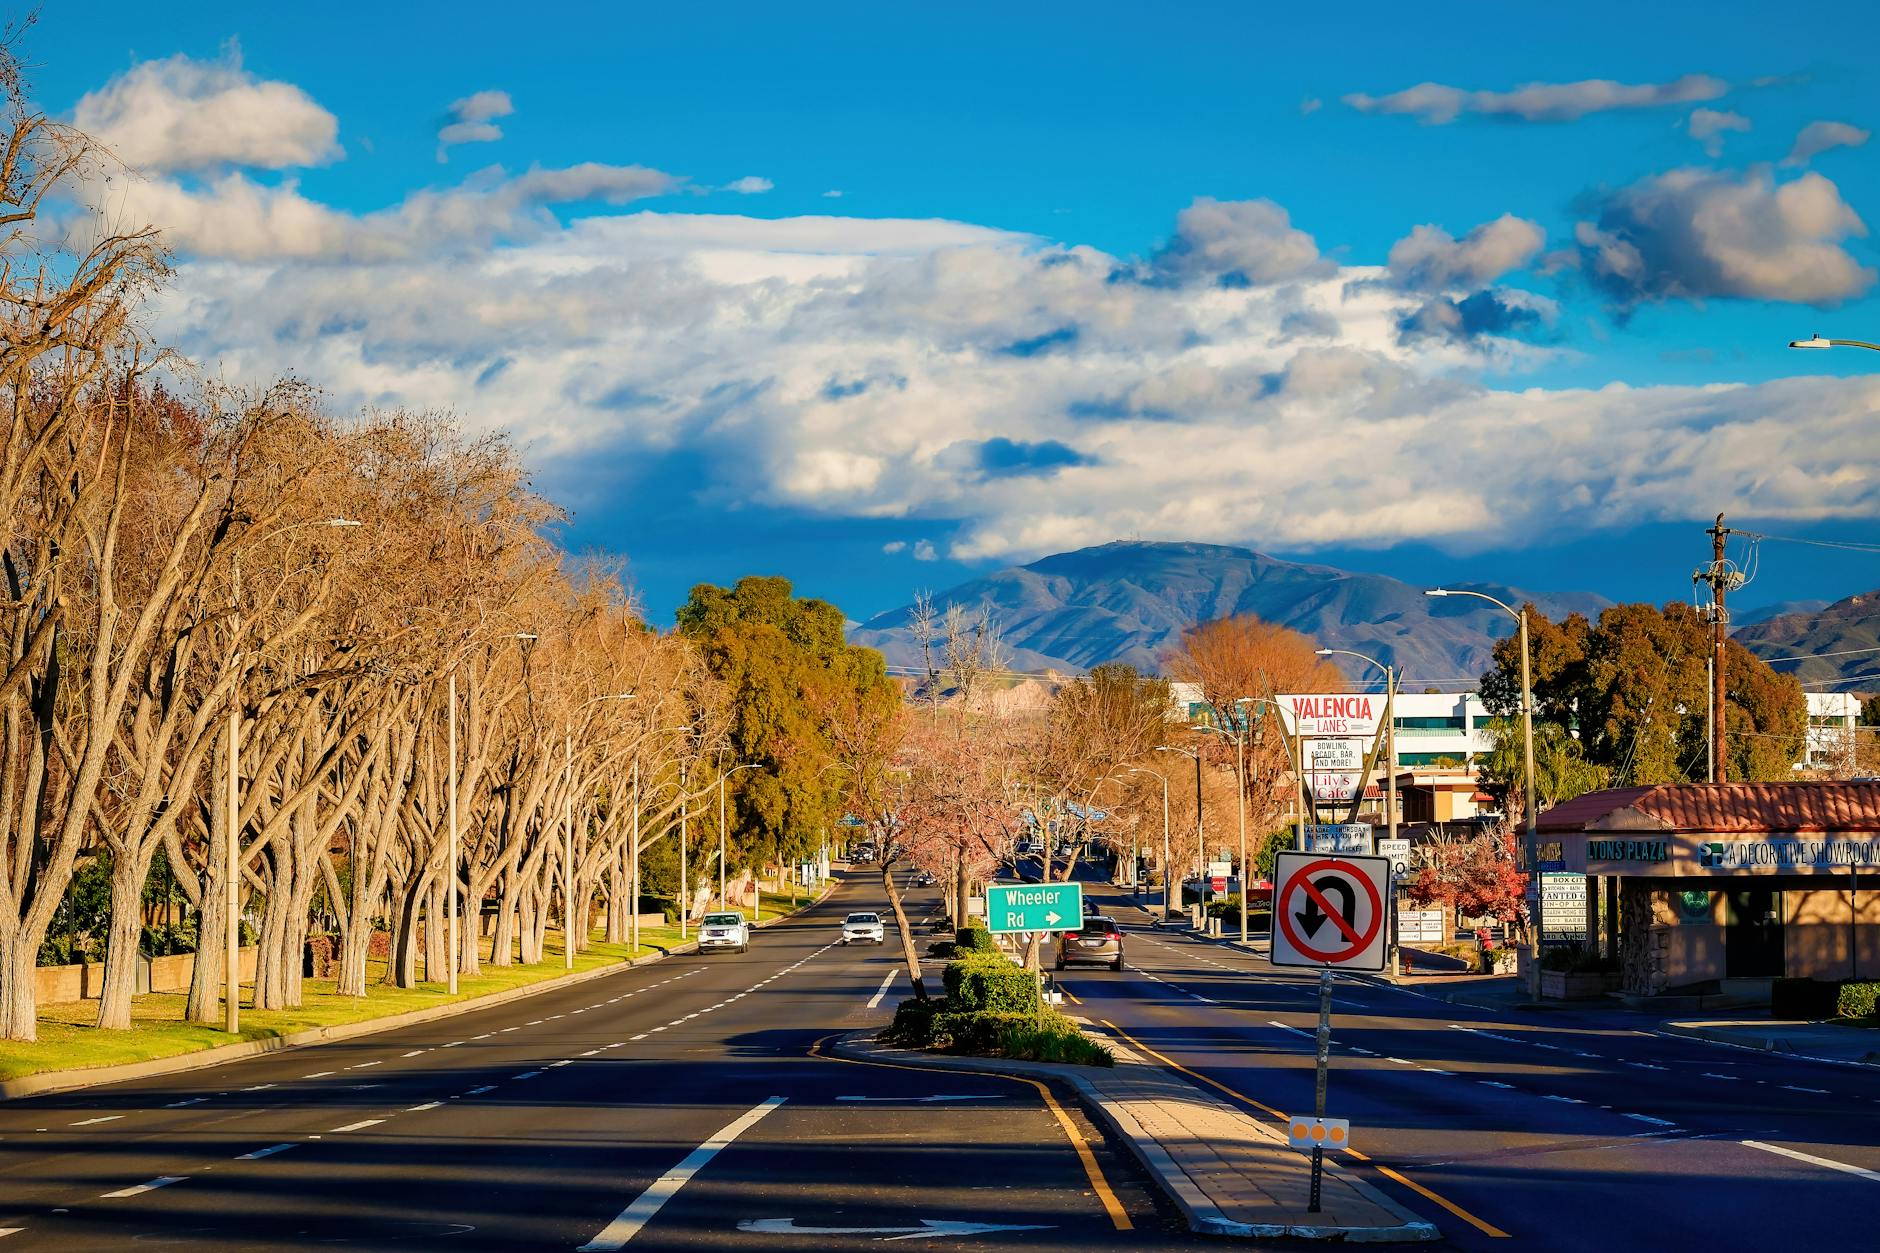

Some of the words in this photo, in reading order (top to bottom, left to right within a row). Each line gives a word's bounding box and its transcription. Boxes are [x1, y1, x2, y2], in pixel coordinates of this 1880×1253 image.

[1292, 697, 1373, 720] VALENCIA
[1317, 720, 1348, 733] LANES
[1317, 742, 1349, 750] BOWLING,
[1311, 751, 1339, 759] RCADE,
[1340, 751, 1356, 759] BAR,
[1315, 759, 1329, 767] AND
[1331, 759, 1352, 767] MORE!
[1315, 774, 1350, 788] Lily's
[1317, 787, 1348, 799] Cafe
[1381, 843, 1407, 851] SPEED
[1586, 841, 1623, 860] LYONS
[1627, 841, 1666, 860] PLAZA
[1729, 843, 1737, 865] A
[1740, 842, 1807, 865] DECORATIVE
[1810, 841, 1880, 863] SHOWROOM
[1005, 890, 1061, 906] Wheeler
[1006, 912, 1025, 928] Rd
